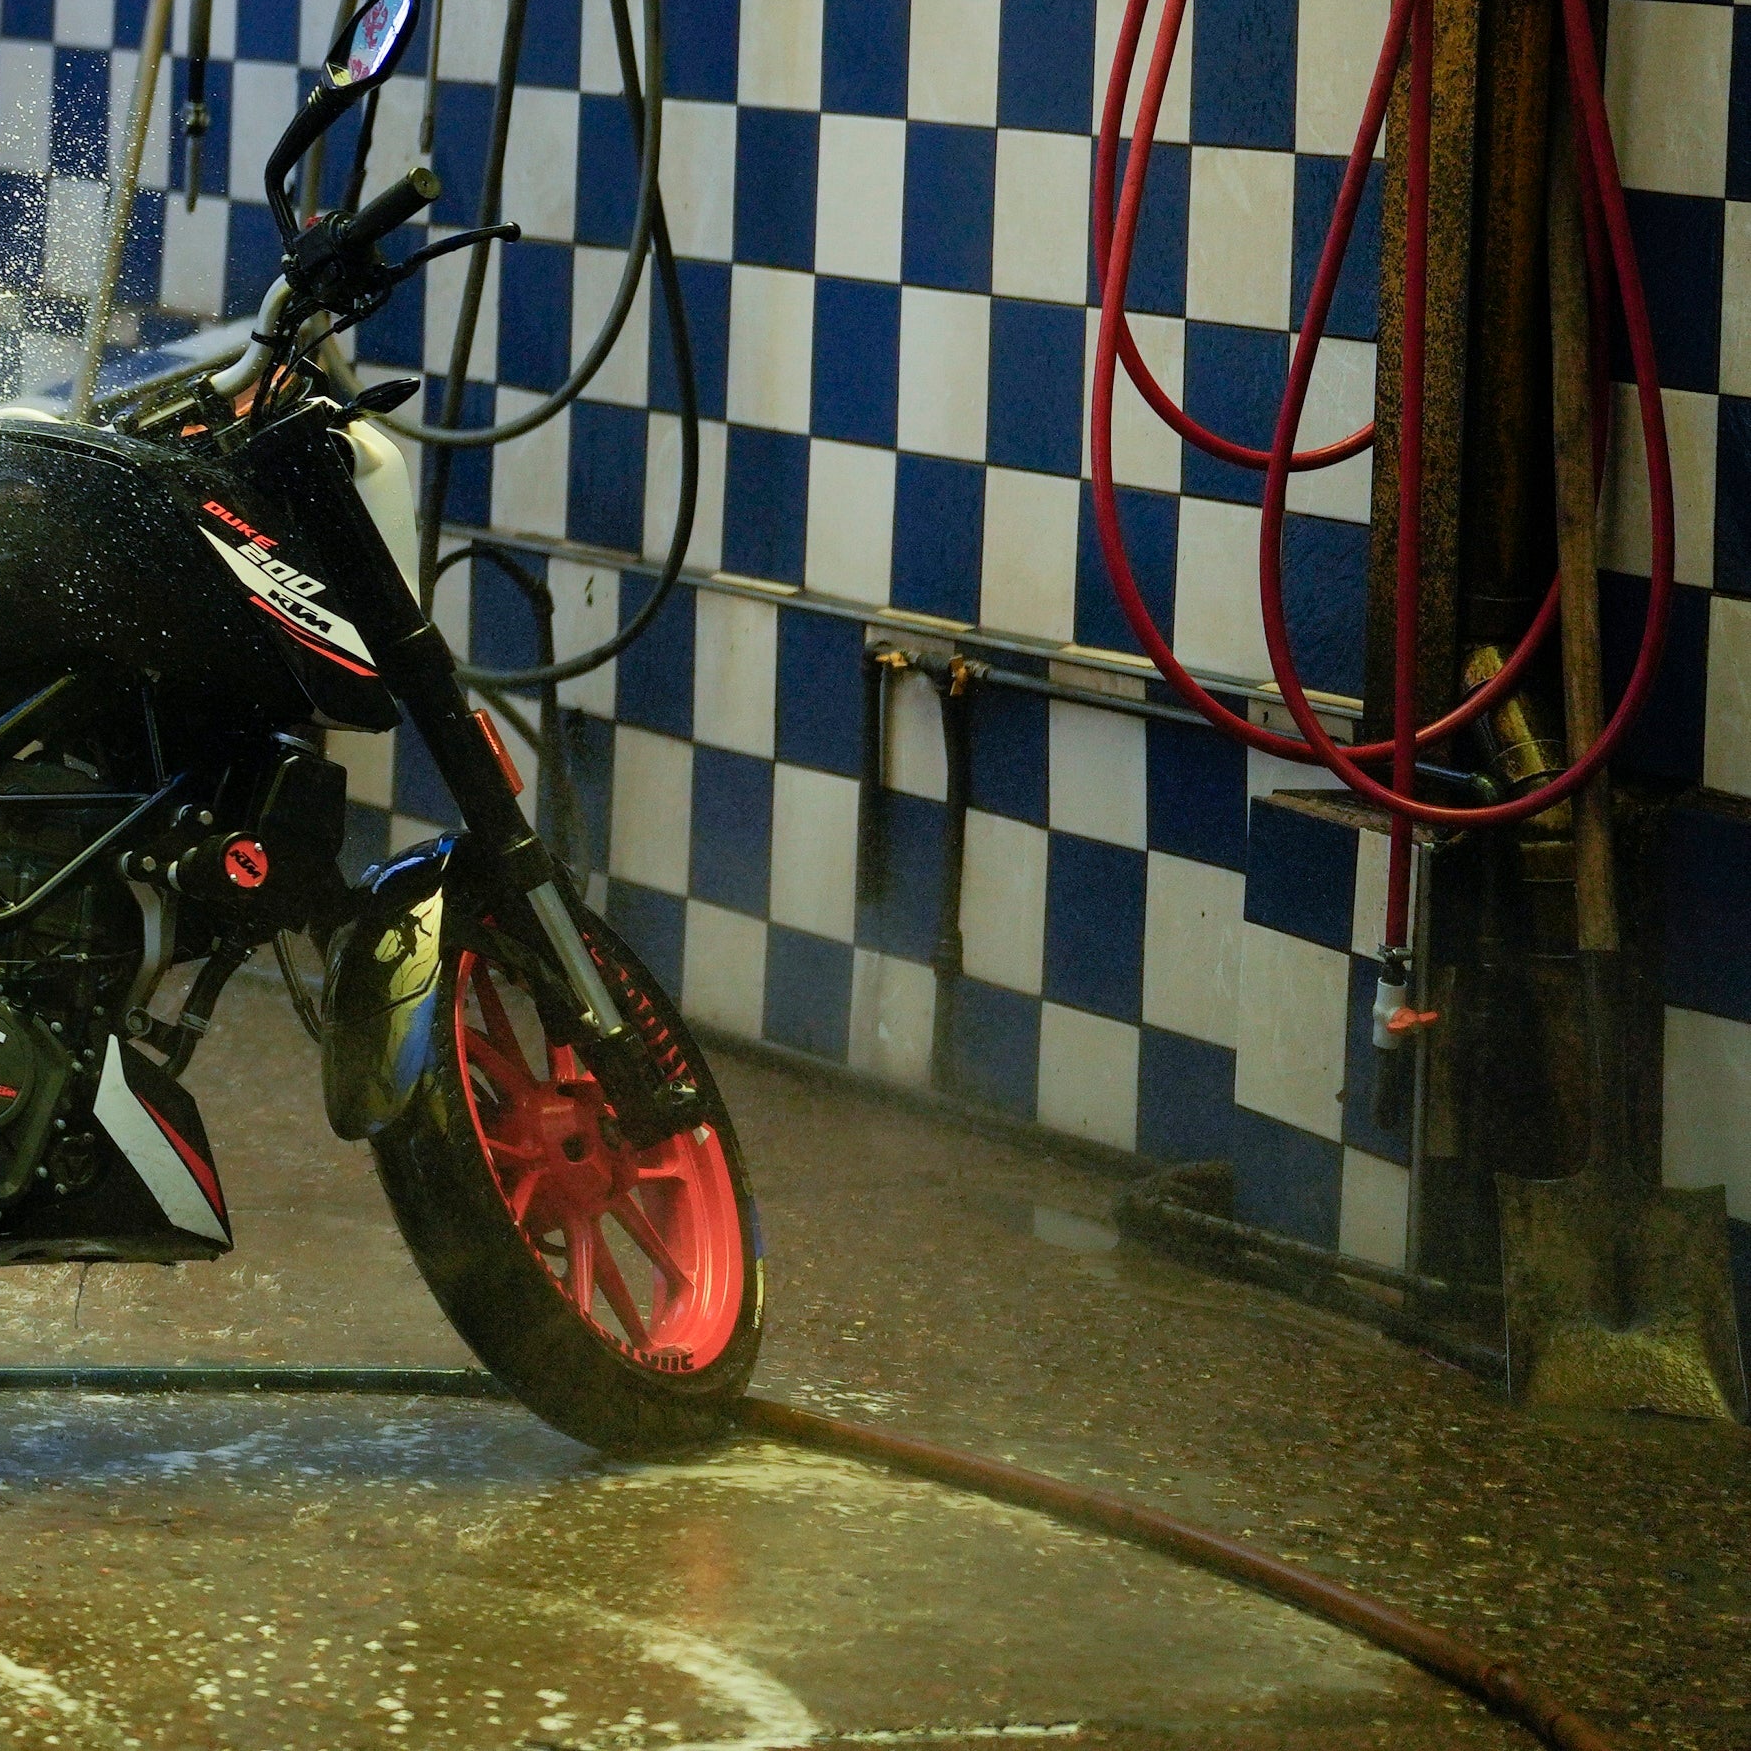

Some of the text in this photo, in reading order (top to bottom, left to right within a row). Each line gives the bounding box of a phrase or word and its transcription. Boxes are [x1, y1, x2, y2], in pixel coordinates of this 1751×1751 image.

[202, 500, 279, 550] DUKE
[237, 541, 327, 598] 200
[267, 589, 334, 634] KTM
[229, 849, 262, 879] KTM
